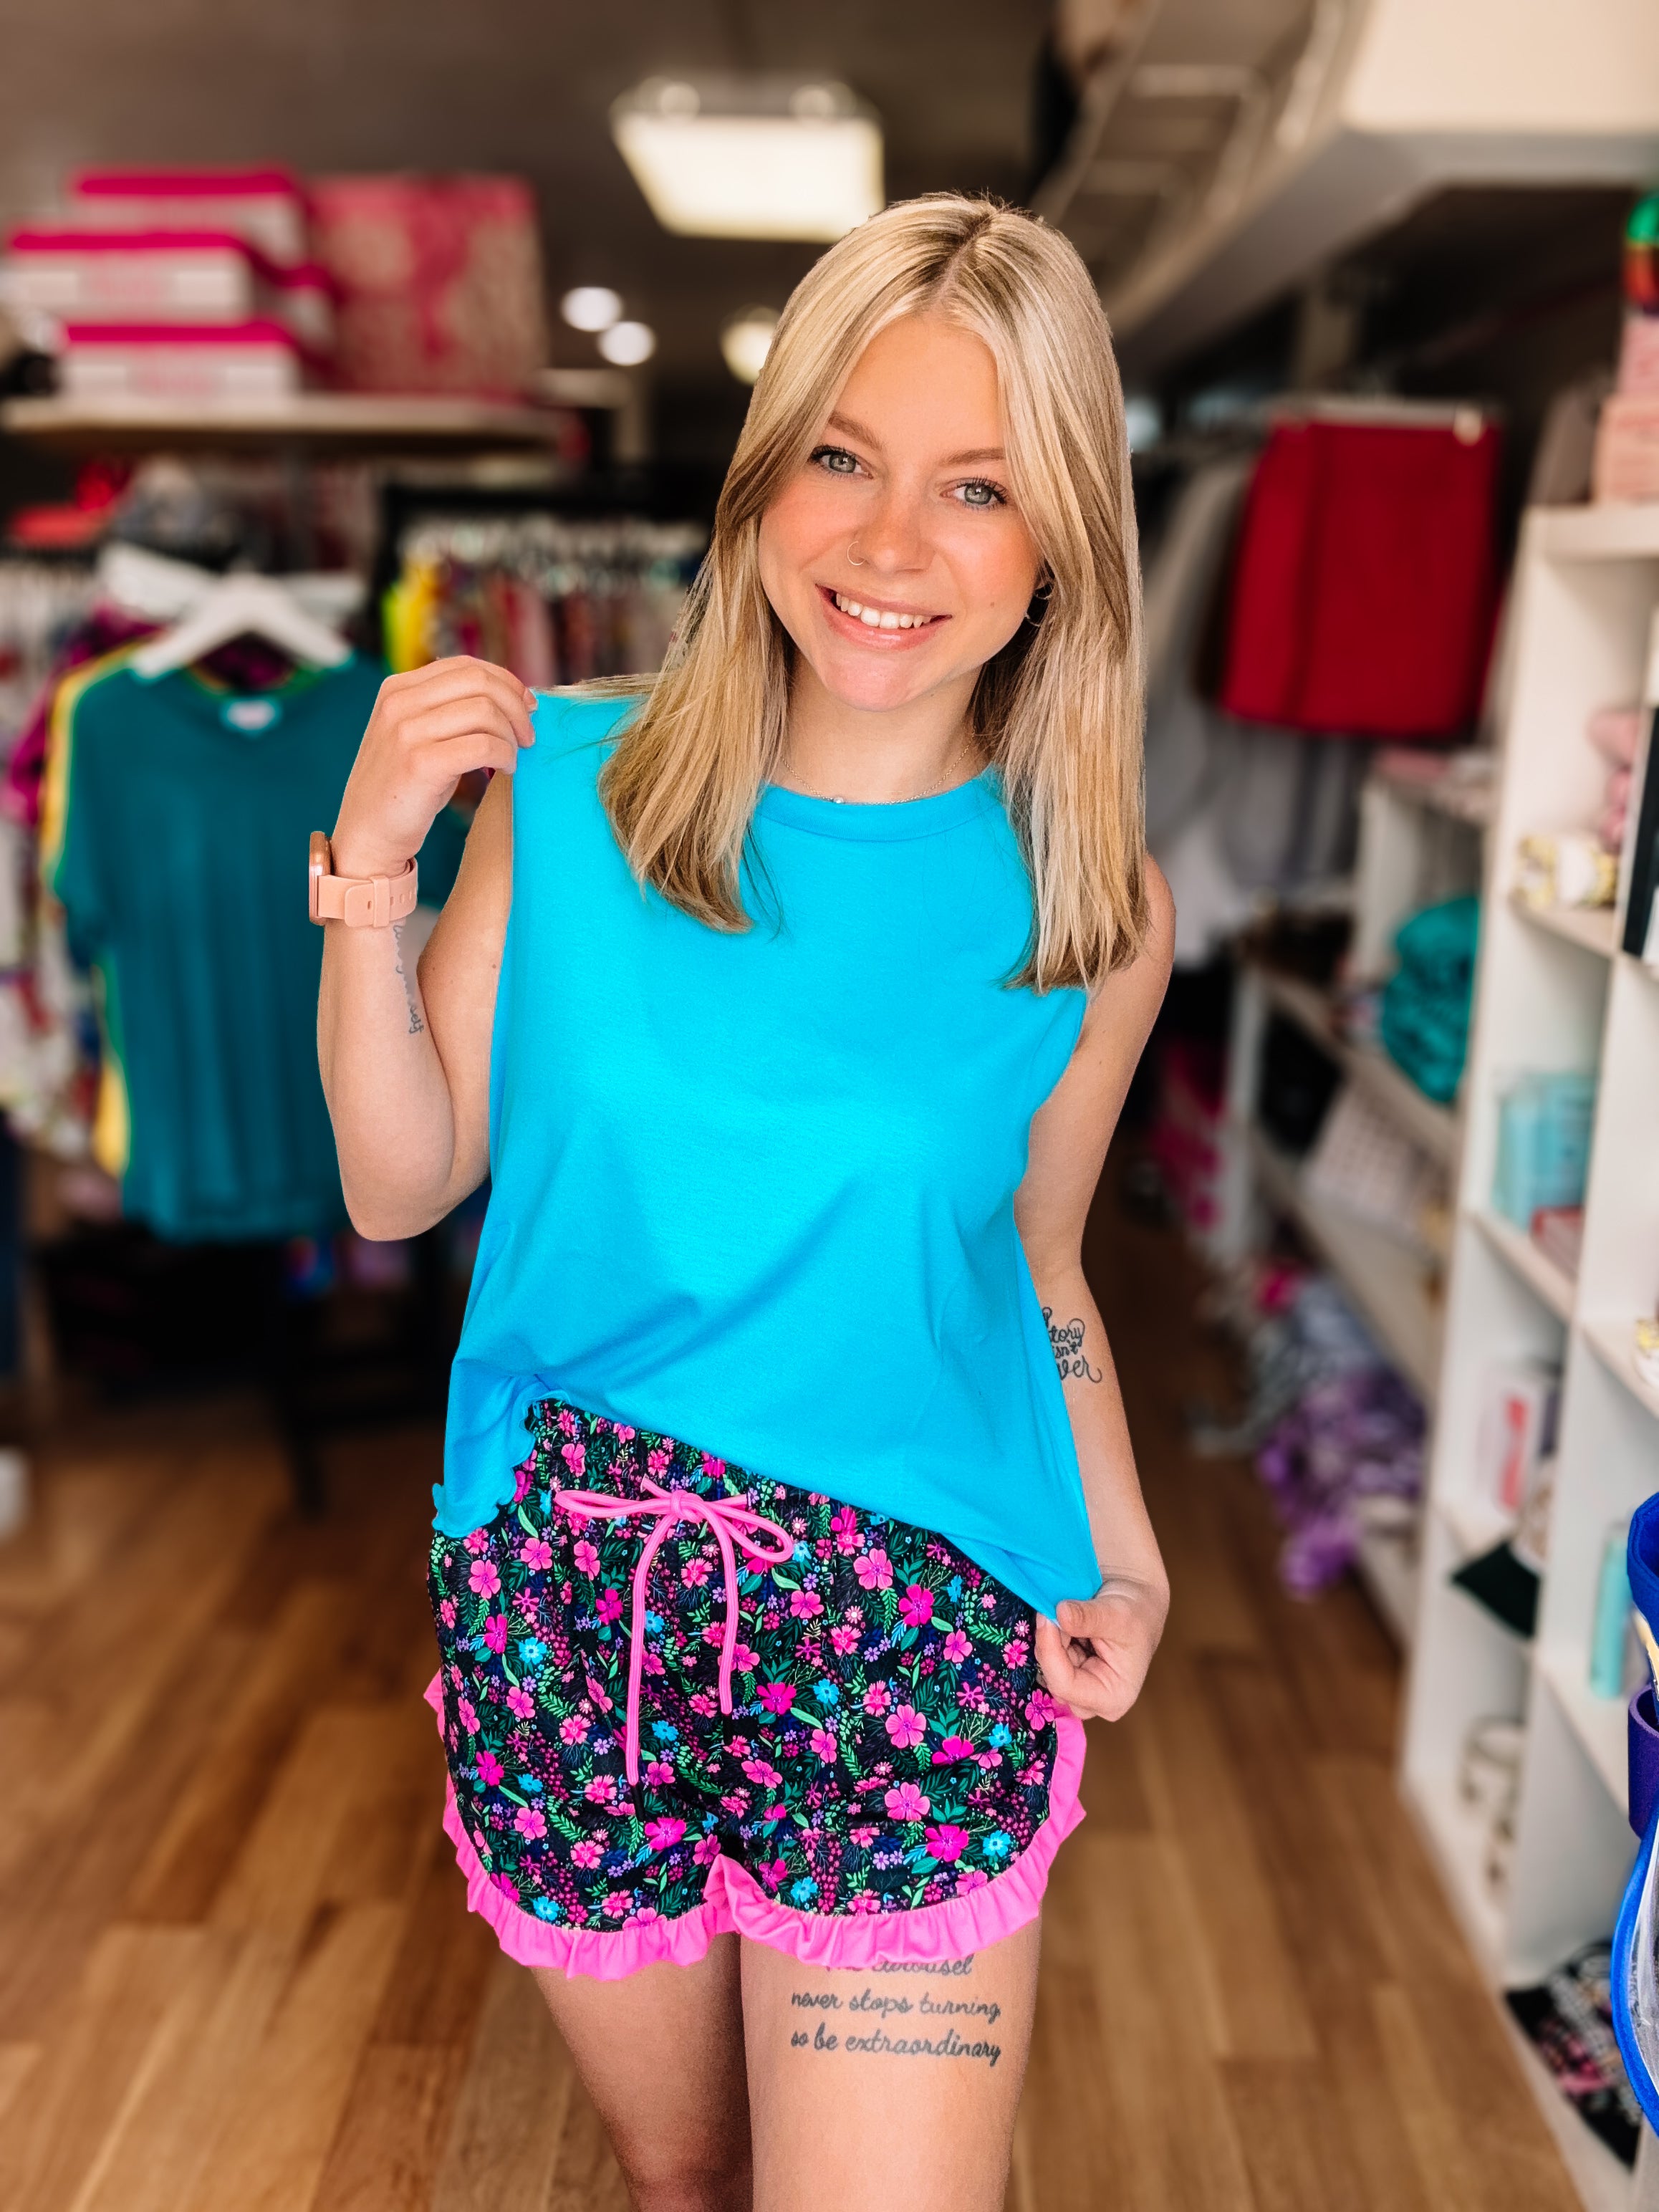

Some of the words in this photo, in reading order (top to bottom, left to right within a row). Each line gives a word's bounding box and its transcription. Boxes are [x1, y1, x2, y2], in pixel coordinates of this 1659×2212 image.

[1056, 1354, 1103, 1384] ver
[791, 1991, 842, 2010] never
[849, 1987, 913, 2019] stops
[920, 1991, 1001, 2024] turning
[790, 2029, 809, 2048] so
[814, 2021, 839, 2052] be
[845, 2028, 1001, 2067] extraordinary
